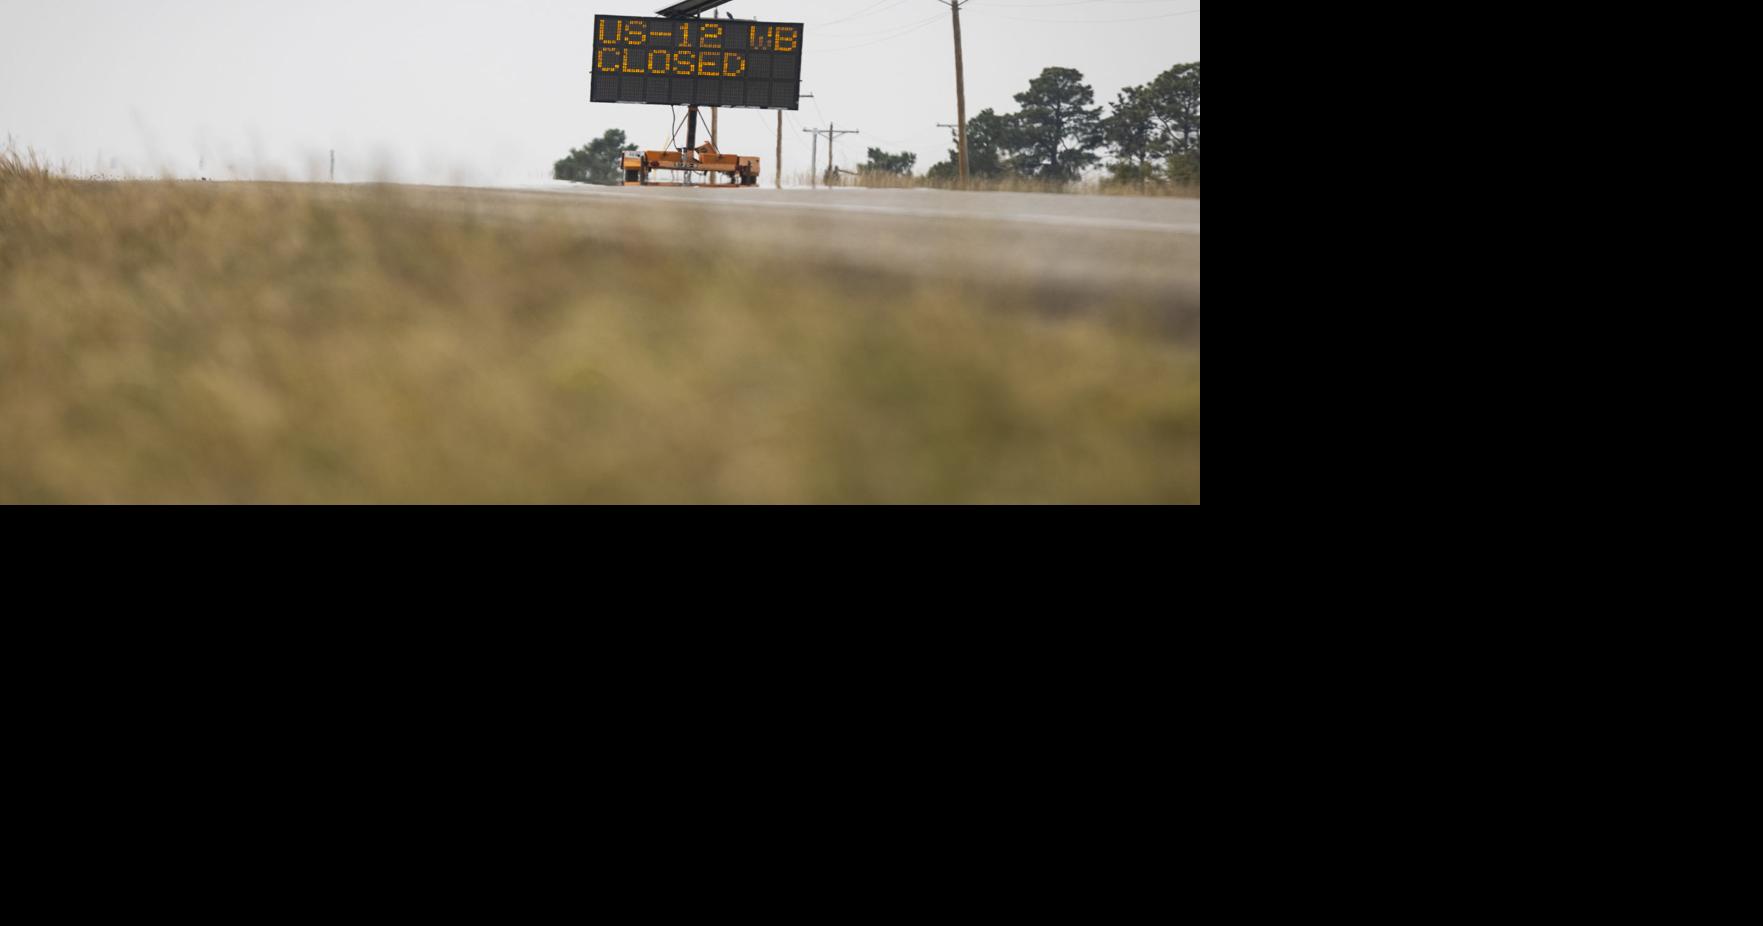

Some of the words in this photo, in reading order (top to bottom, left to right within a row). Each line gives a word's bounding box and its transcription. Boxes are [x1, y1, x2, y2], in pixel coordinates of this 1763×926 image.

[599, 19, 723, 48] US-12
[750, 25, 798, 51] WB
[597, 47, 746, 77] CLOSED
